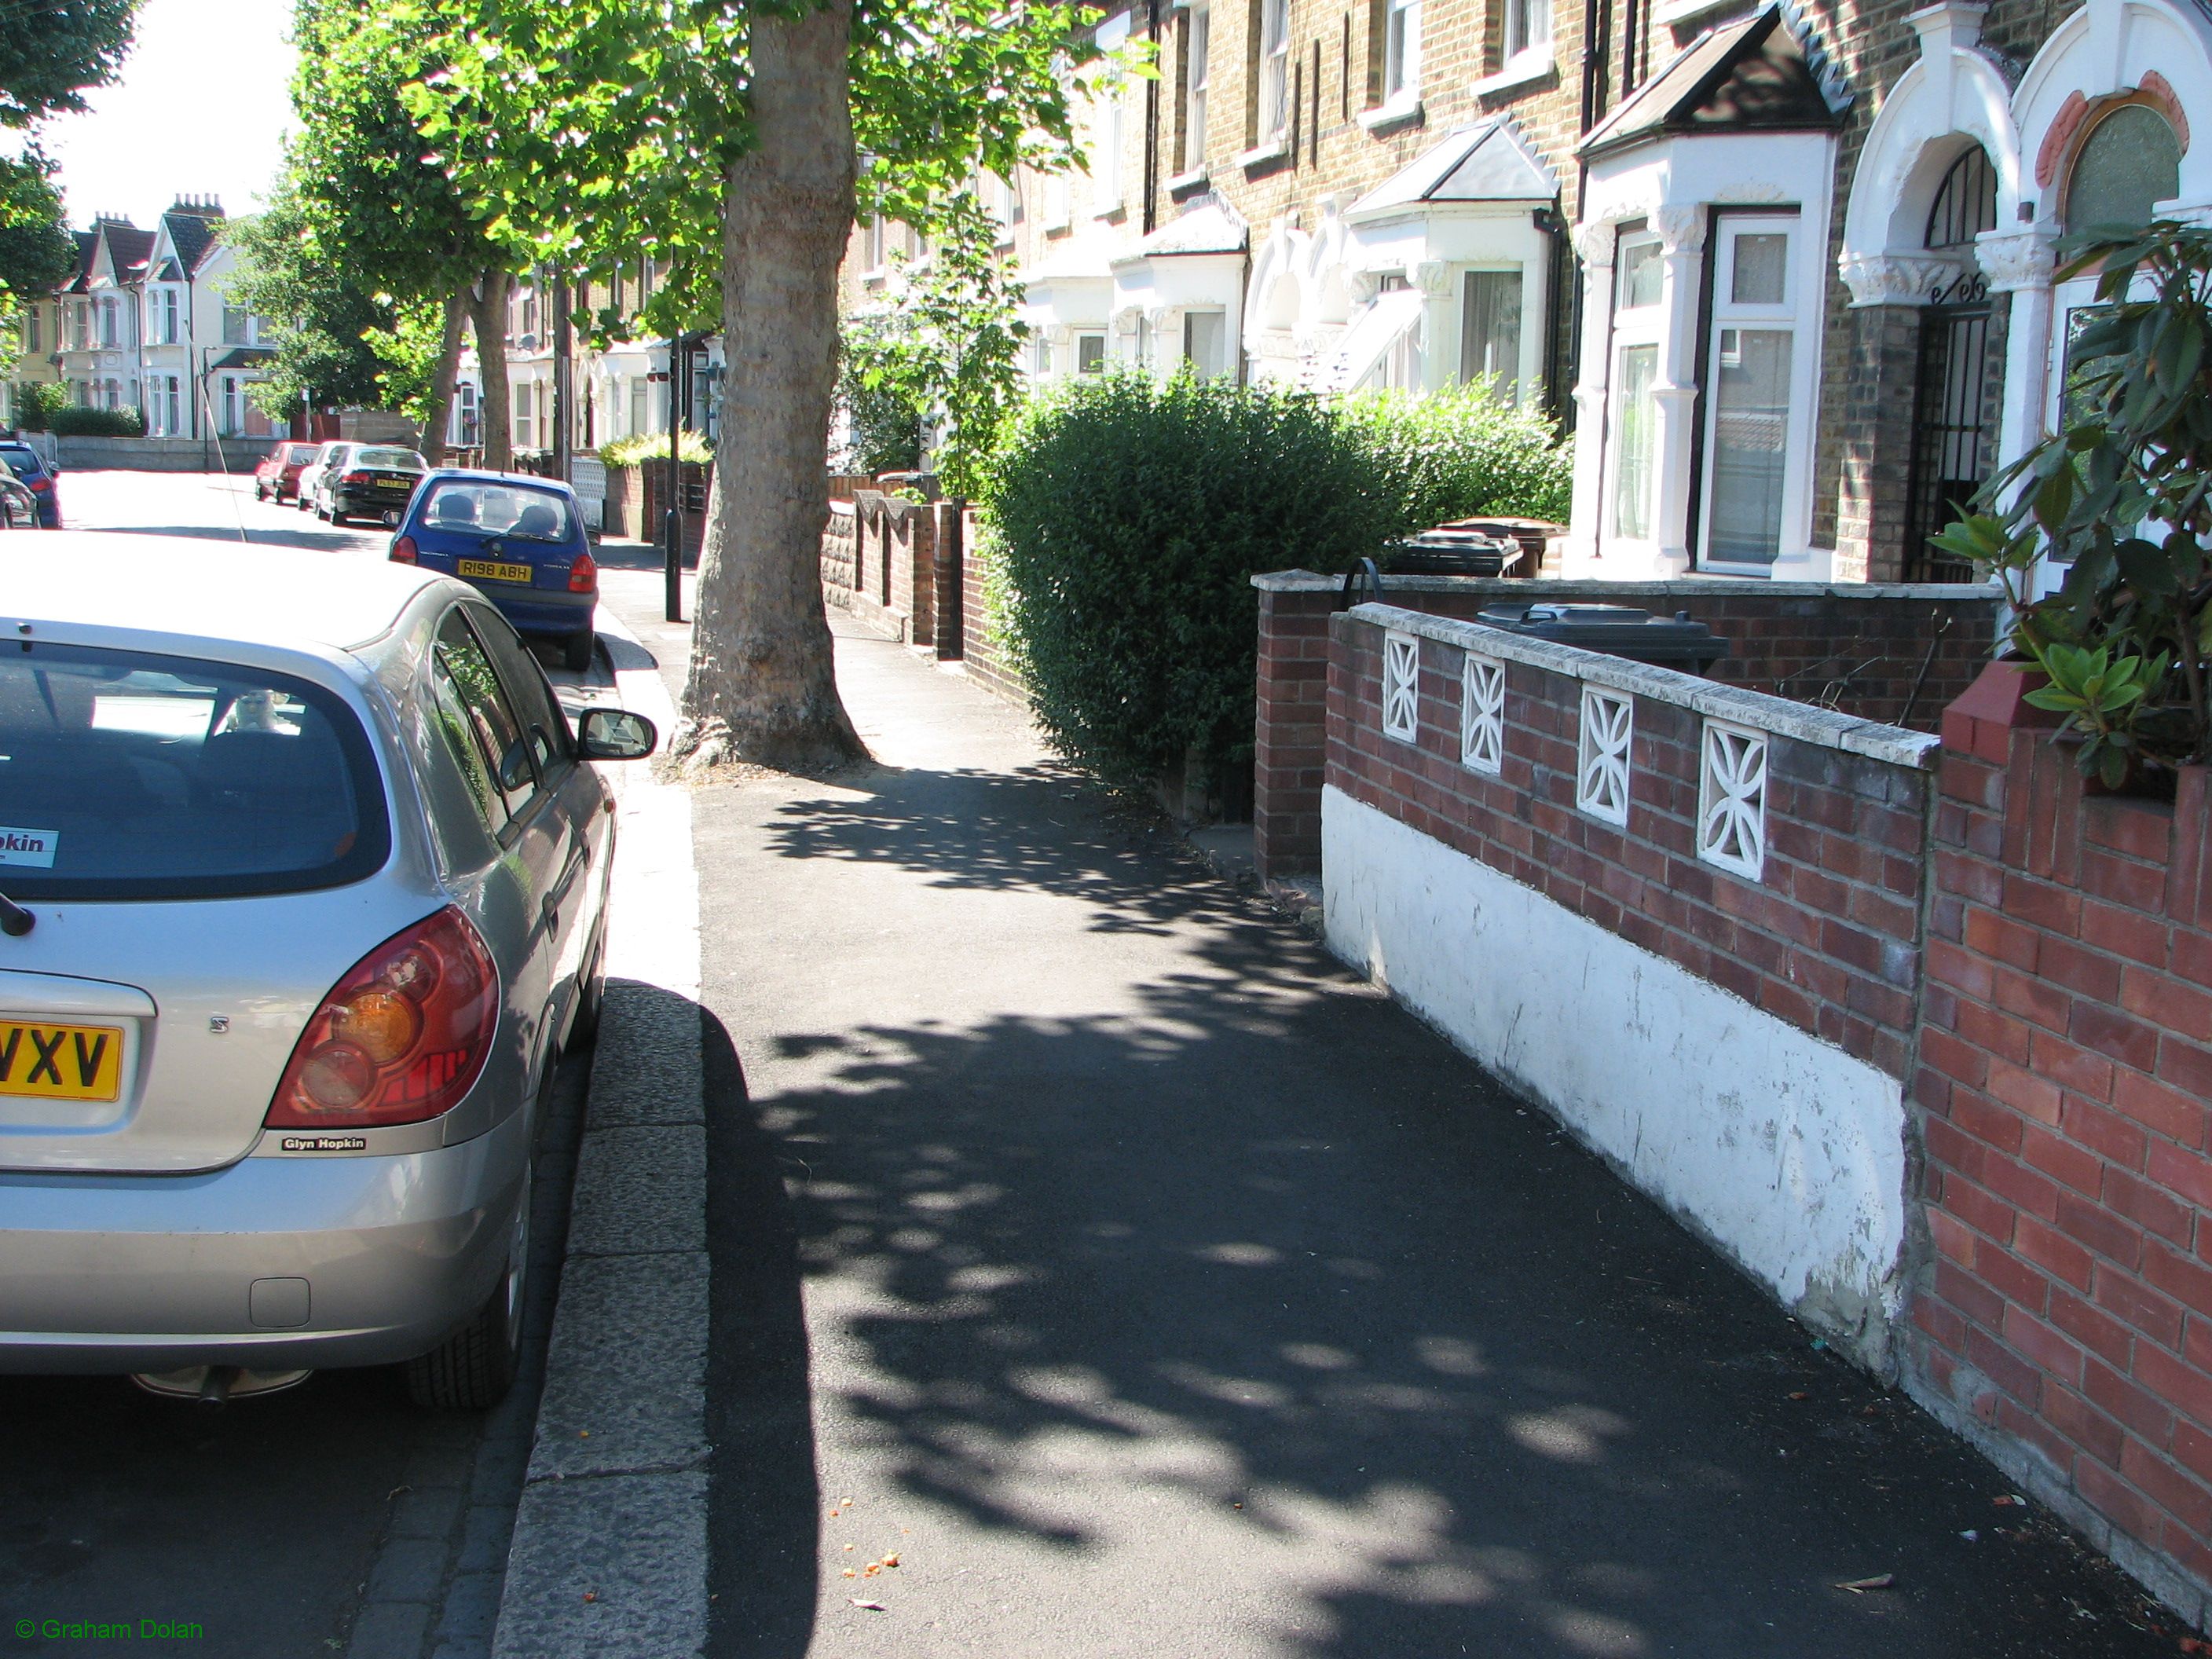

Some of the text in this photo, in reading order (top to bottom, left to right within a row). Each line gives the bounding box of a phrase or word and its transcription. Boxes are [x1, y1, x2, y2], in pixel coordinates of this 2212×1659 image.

[463, 562, 527, 579] R198 ABH
[285, 1138, 364, 1150] Glyn Hopkin
